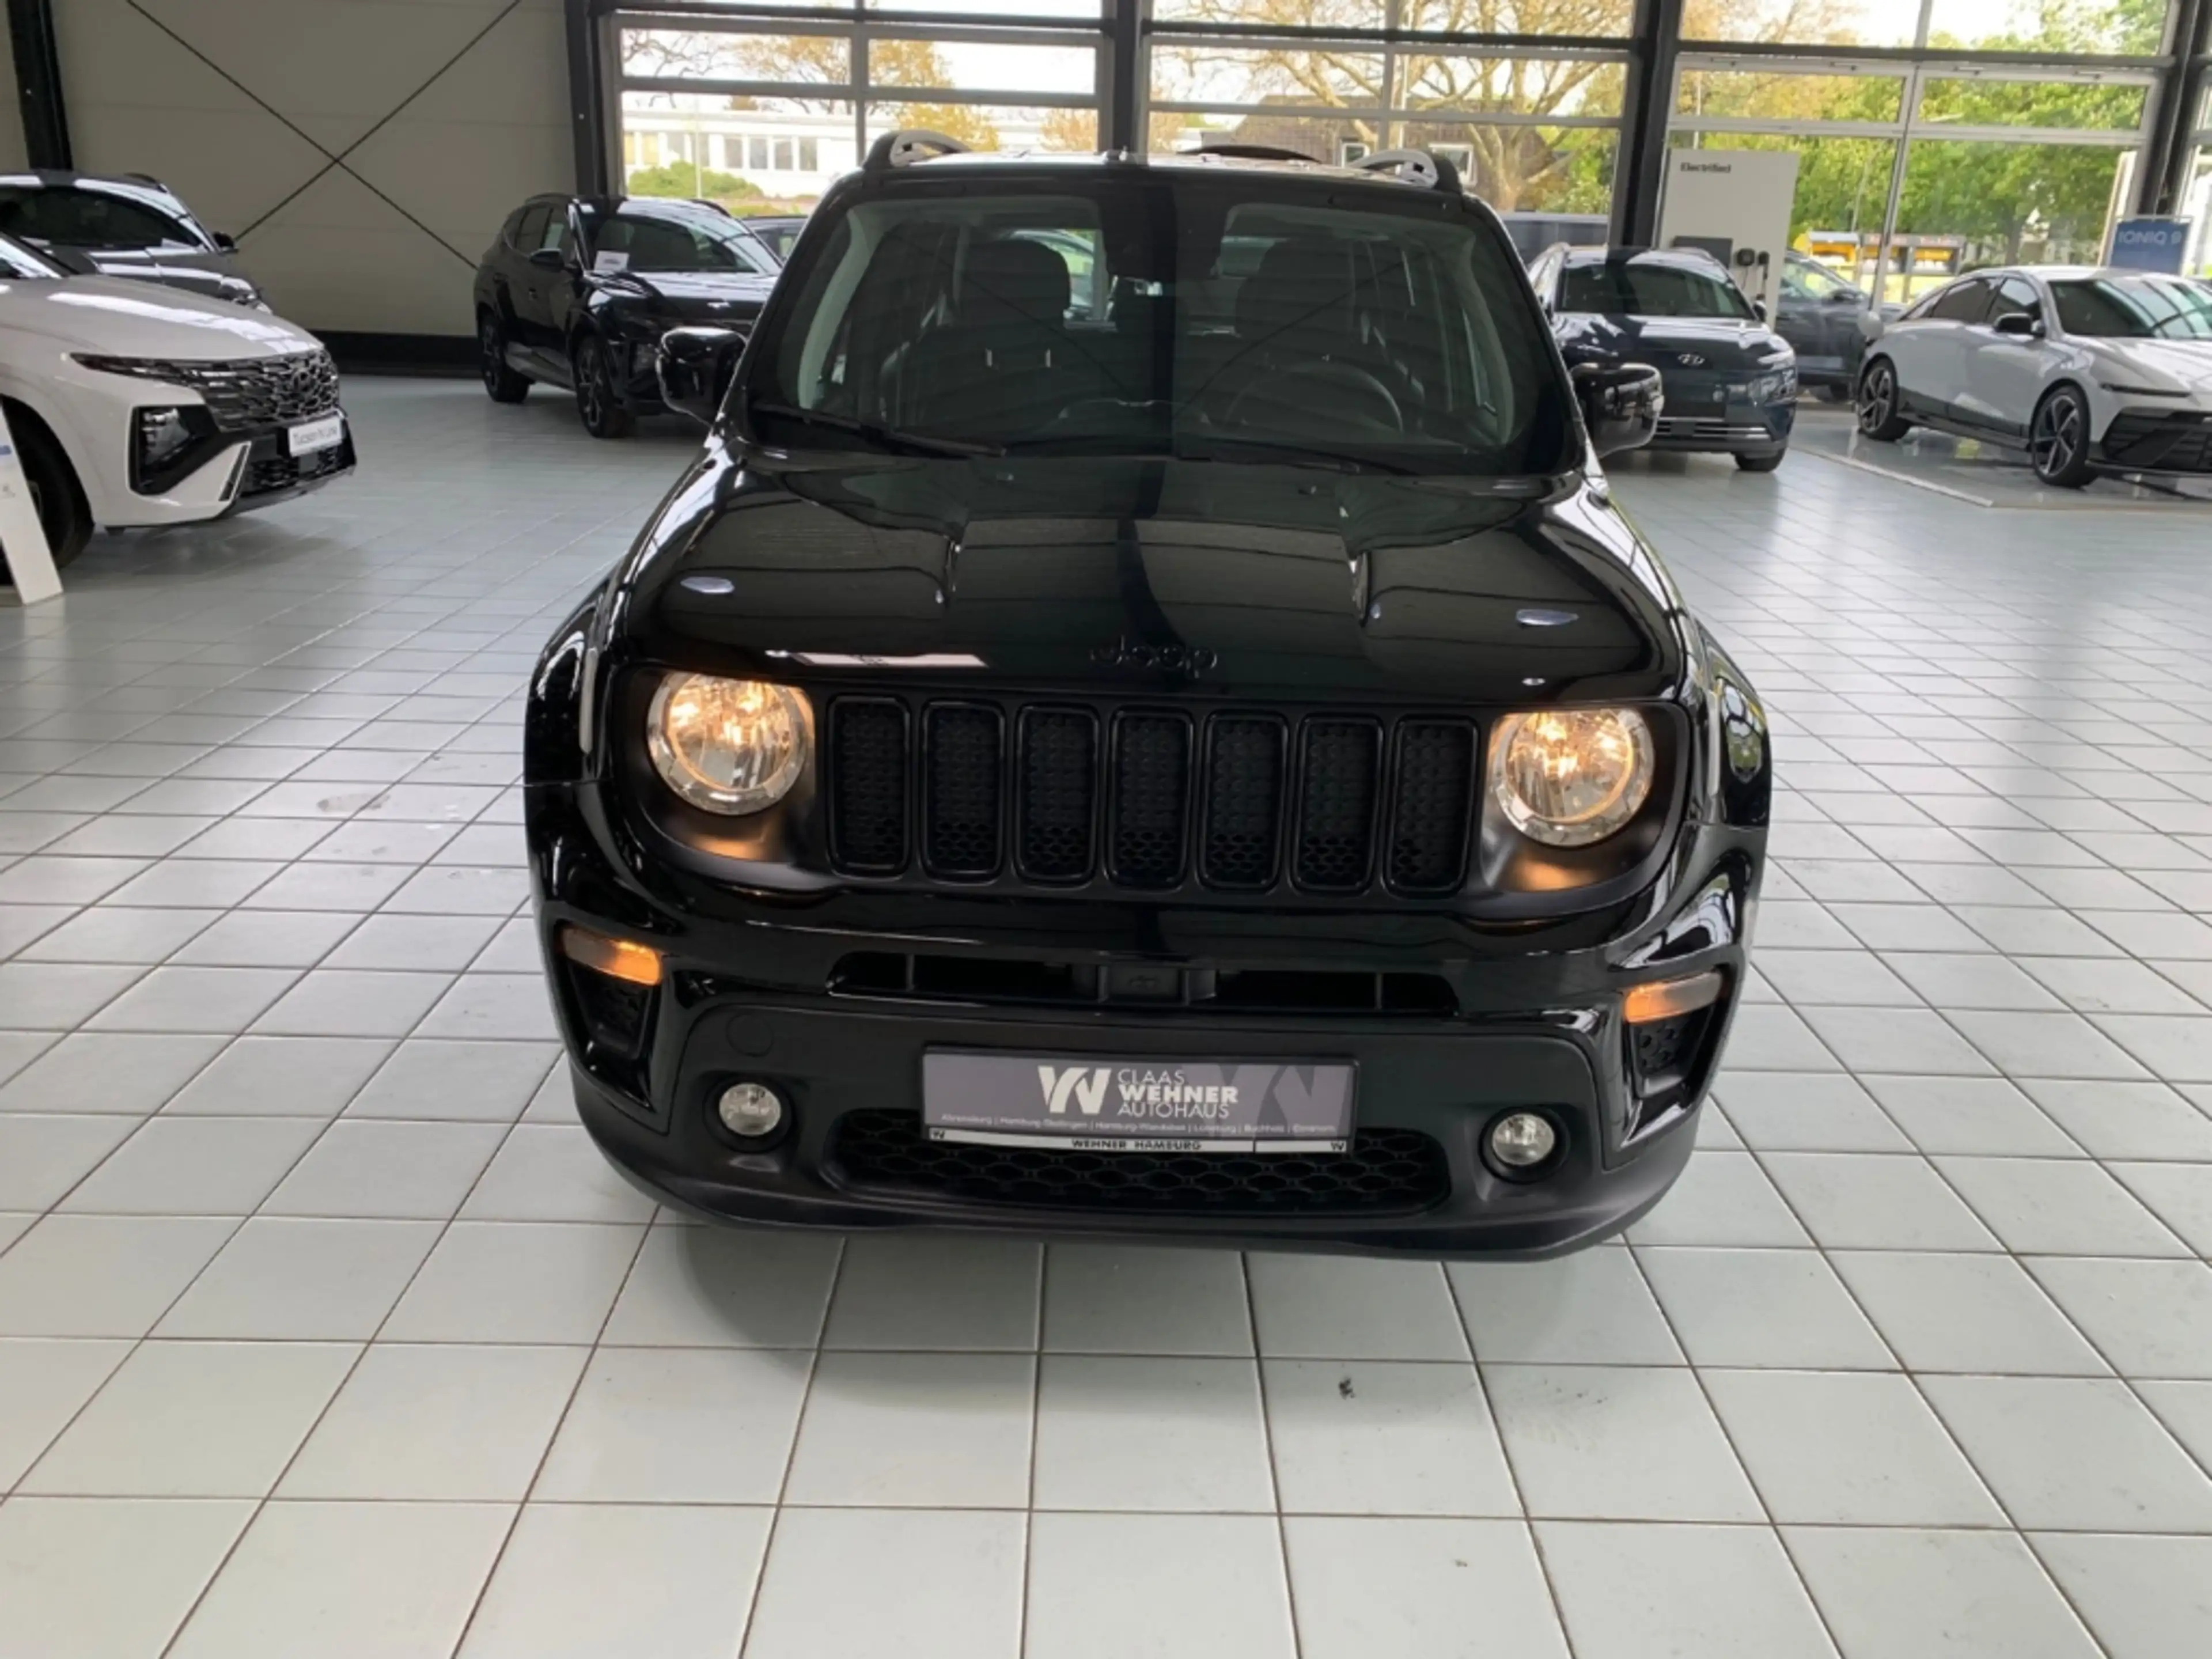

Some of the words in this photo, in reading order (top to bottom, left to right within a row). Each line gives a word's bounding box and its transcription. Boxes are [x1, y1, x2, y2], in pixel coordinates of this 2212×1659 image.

[1680, 162, 1732, 173] Electrified
[2119, 230, 2167, 246] IONIQ
[1117, 1069, 1184, 1085] CLAAS
[1118, 1084, 1238, 1103] WEHNER
[1117, 1103, 1229, 1119] AUTOHAUS
[1072, 1139, 1127, 1149] WEHNER
[1134, 1140, 1202, 1150] HAMBURG
